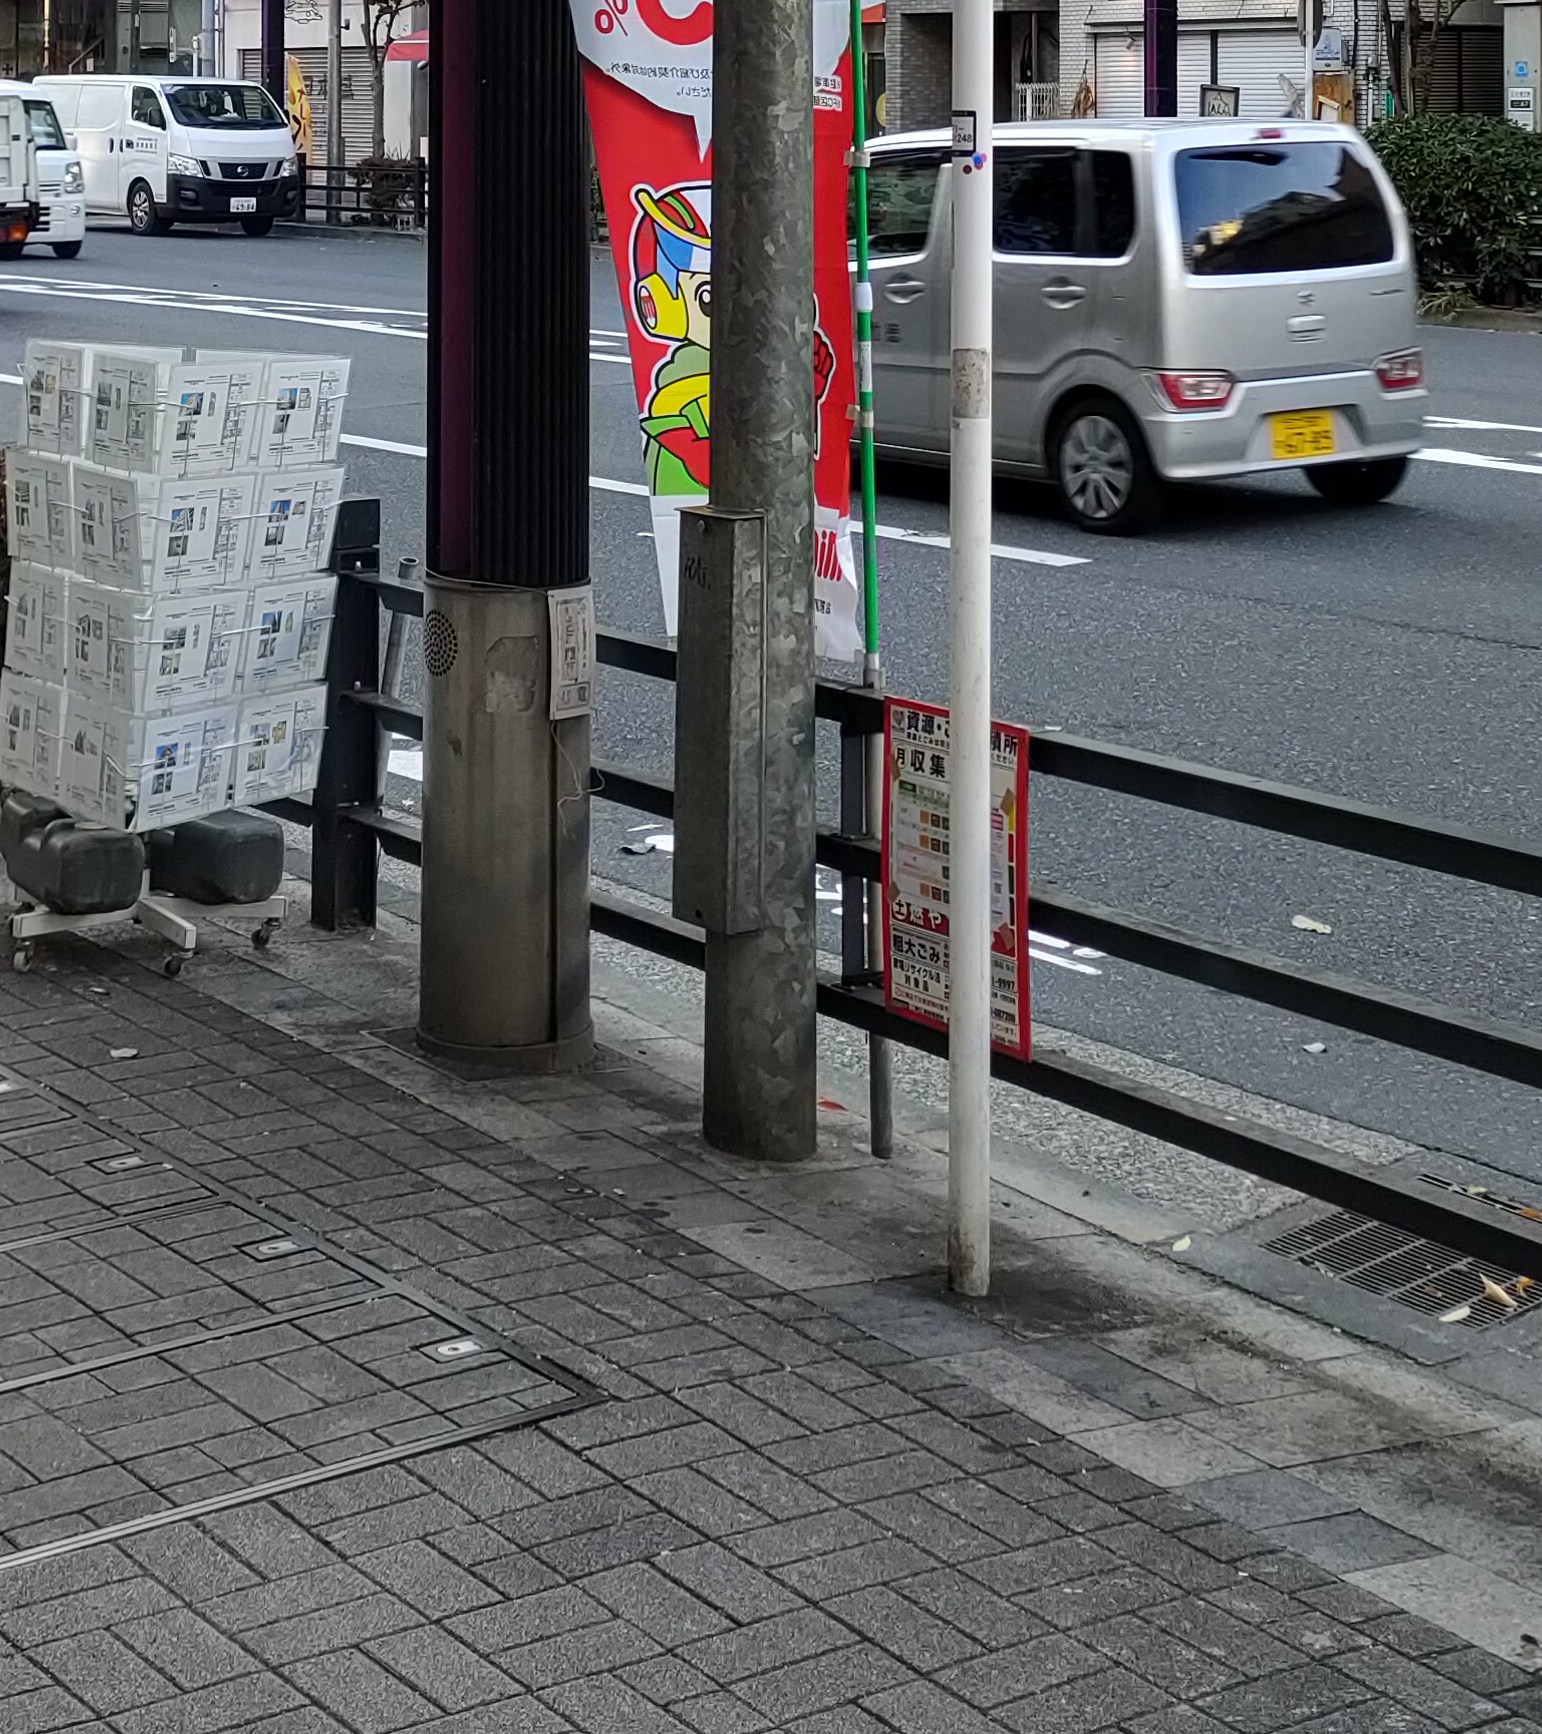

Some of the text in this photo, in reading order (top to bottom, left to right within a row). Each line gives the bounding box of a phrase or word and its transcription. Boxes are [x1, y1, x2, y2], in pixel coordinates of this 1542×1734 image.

[896, 747, 946, 779] 月 収集
[894, 901, 905, 917] 土
[892, 933, 941, 964] 粗大ごみ
